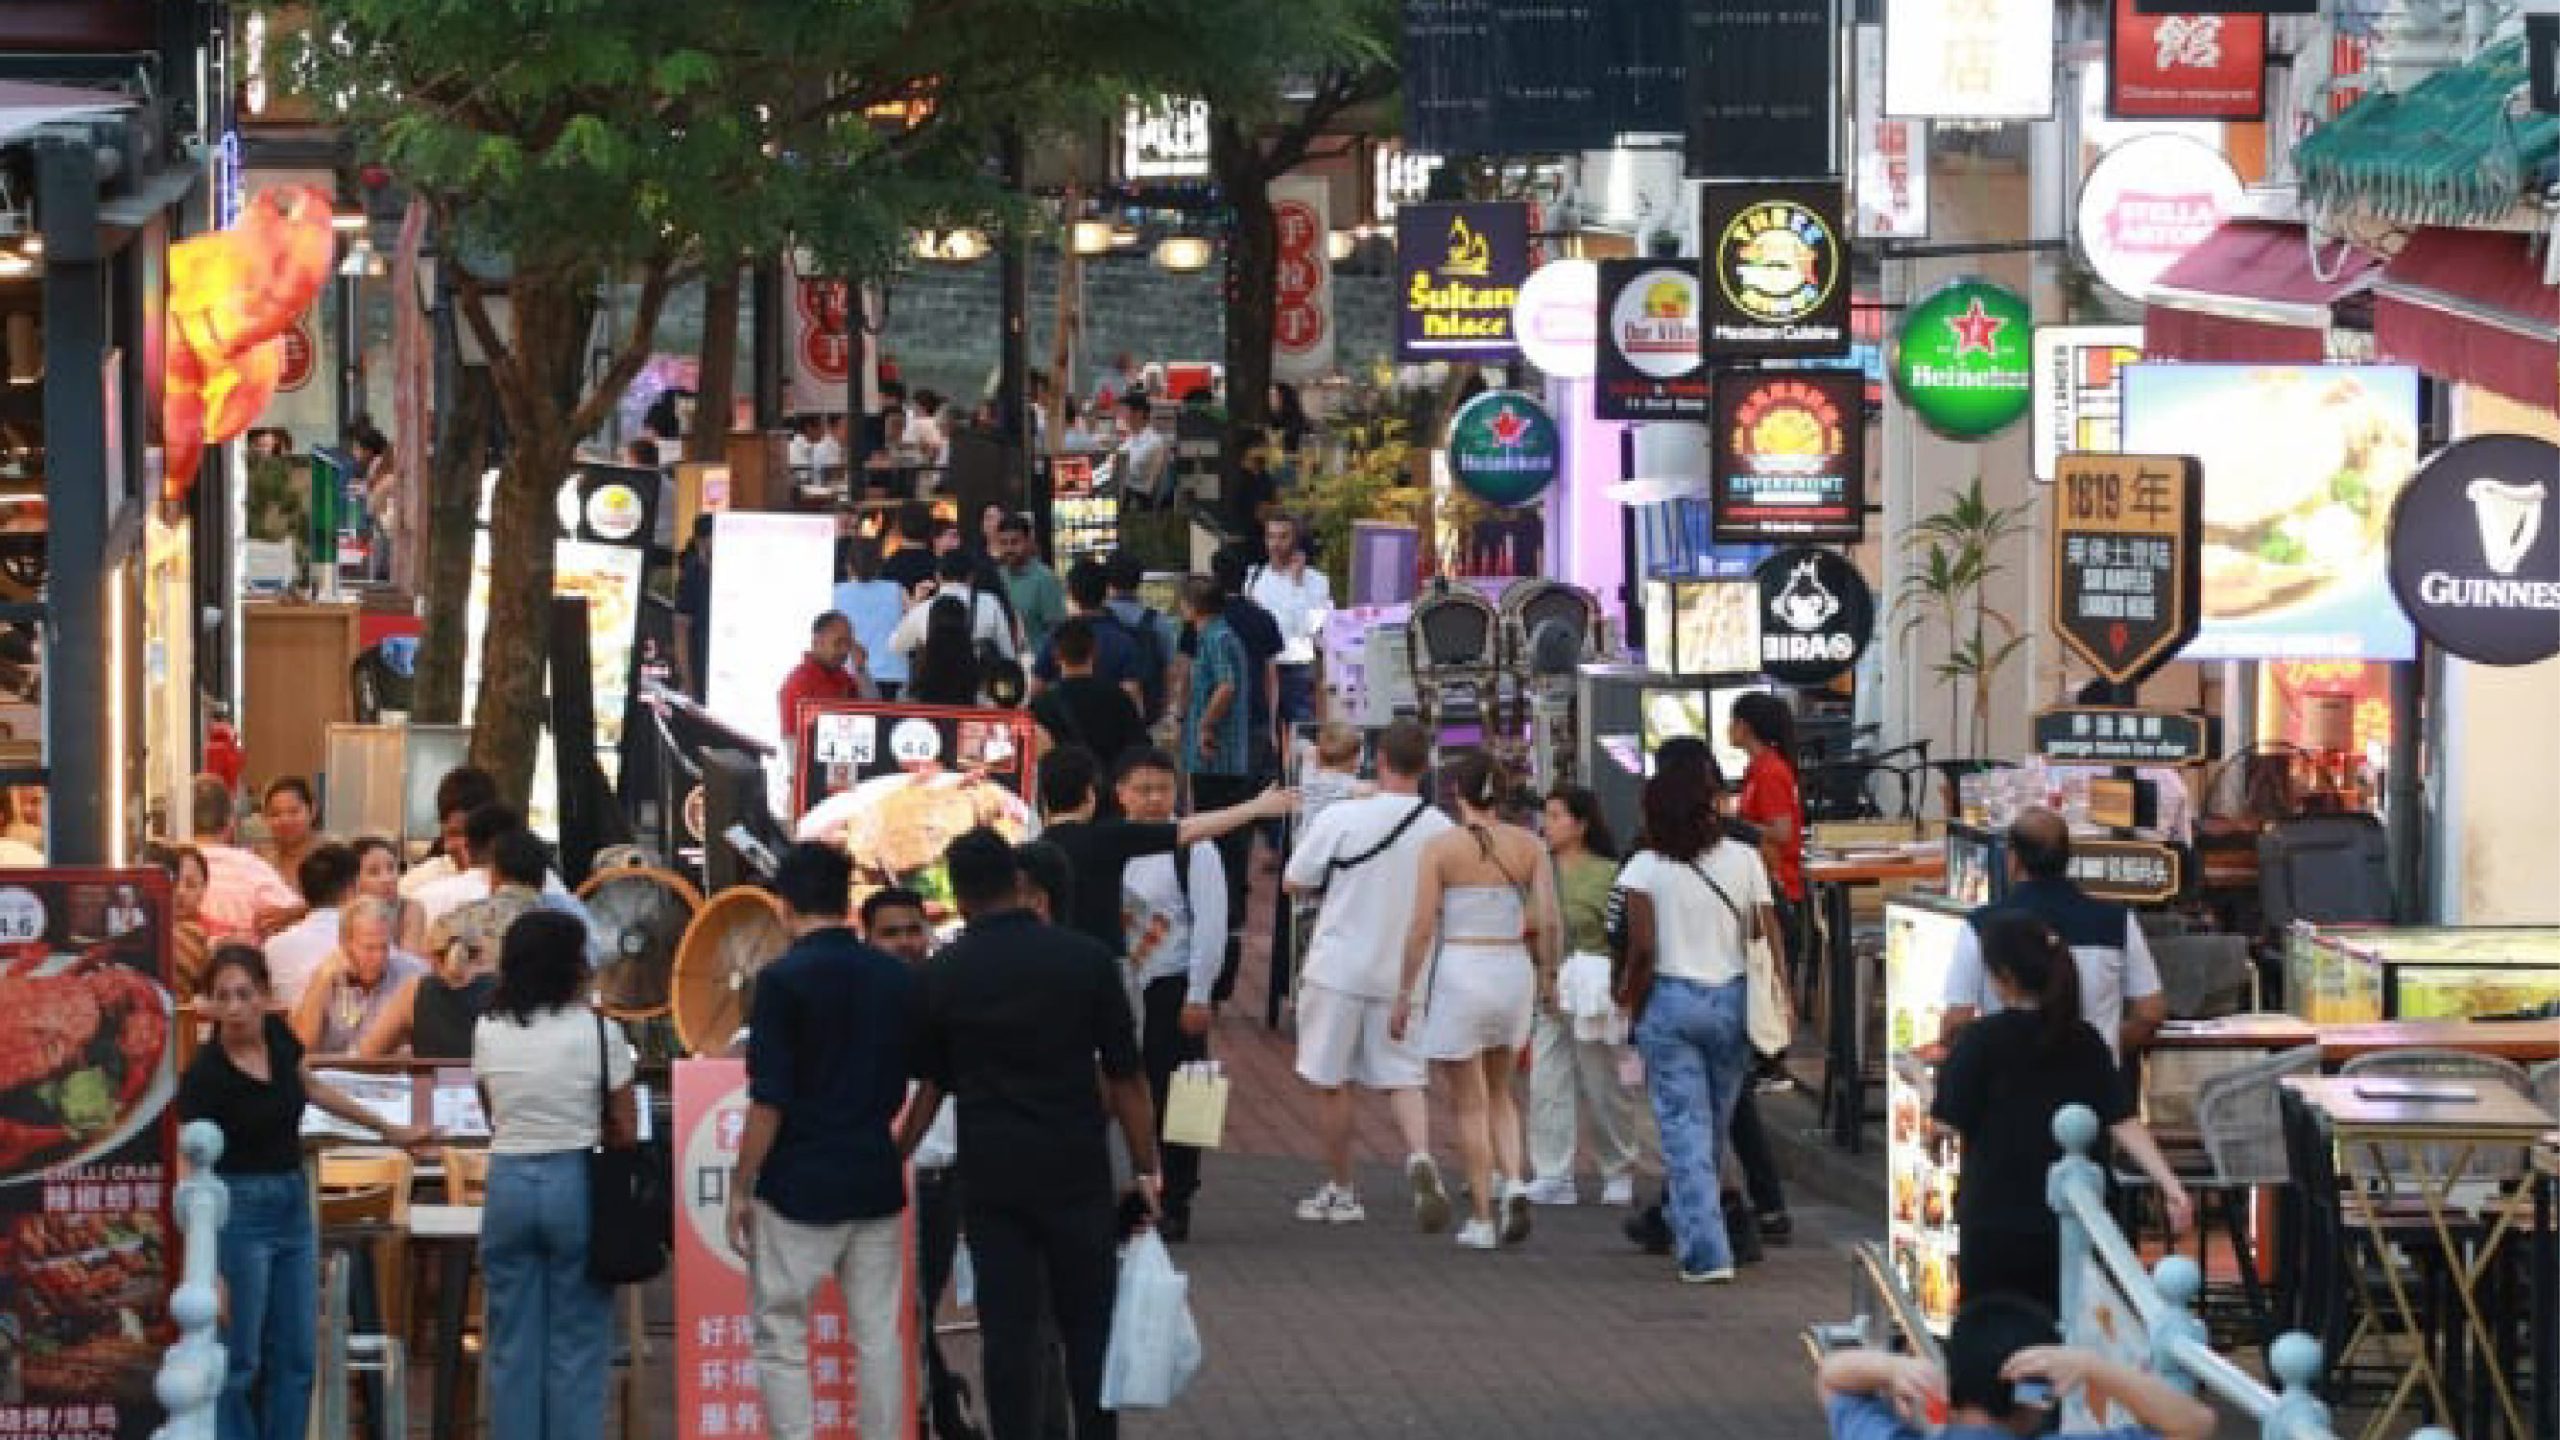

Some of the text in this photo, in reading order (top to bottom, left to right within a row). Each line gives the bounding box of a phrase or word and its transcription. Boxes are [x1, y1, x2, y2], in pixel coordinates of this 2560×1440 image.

[1734, 208, 1824, 245] THREE
[1408, 270, 1520, 311] Sultan
[1423, 312, 1507, 337] Palace
[1713, 324, 1839, 341] Mexican Cuisine
[1460, 453, 1552, 473] Heineken
[2066, 464, 2171, 527] 1819 年
